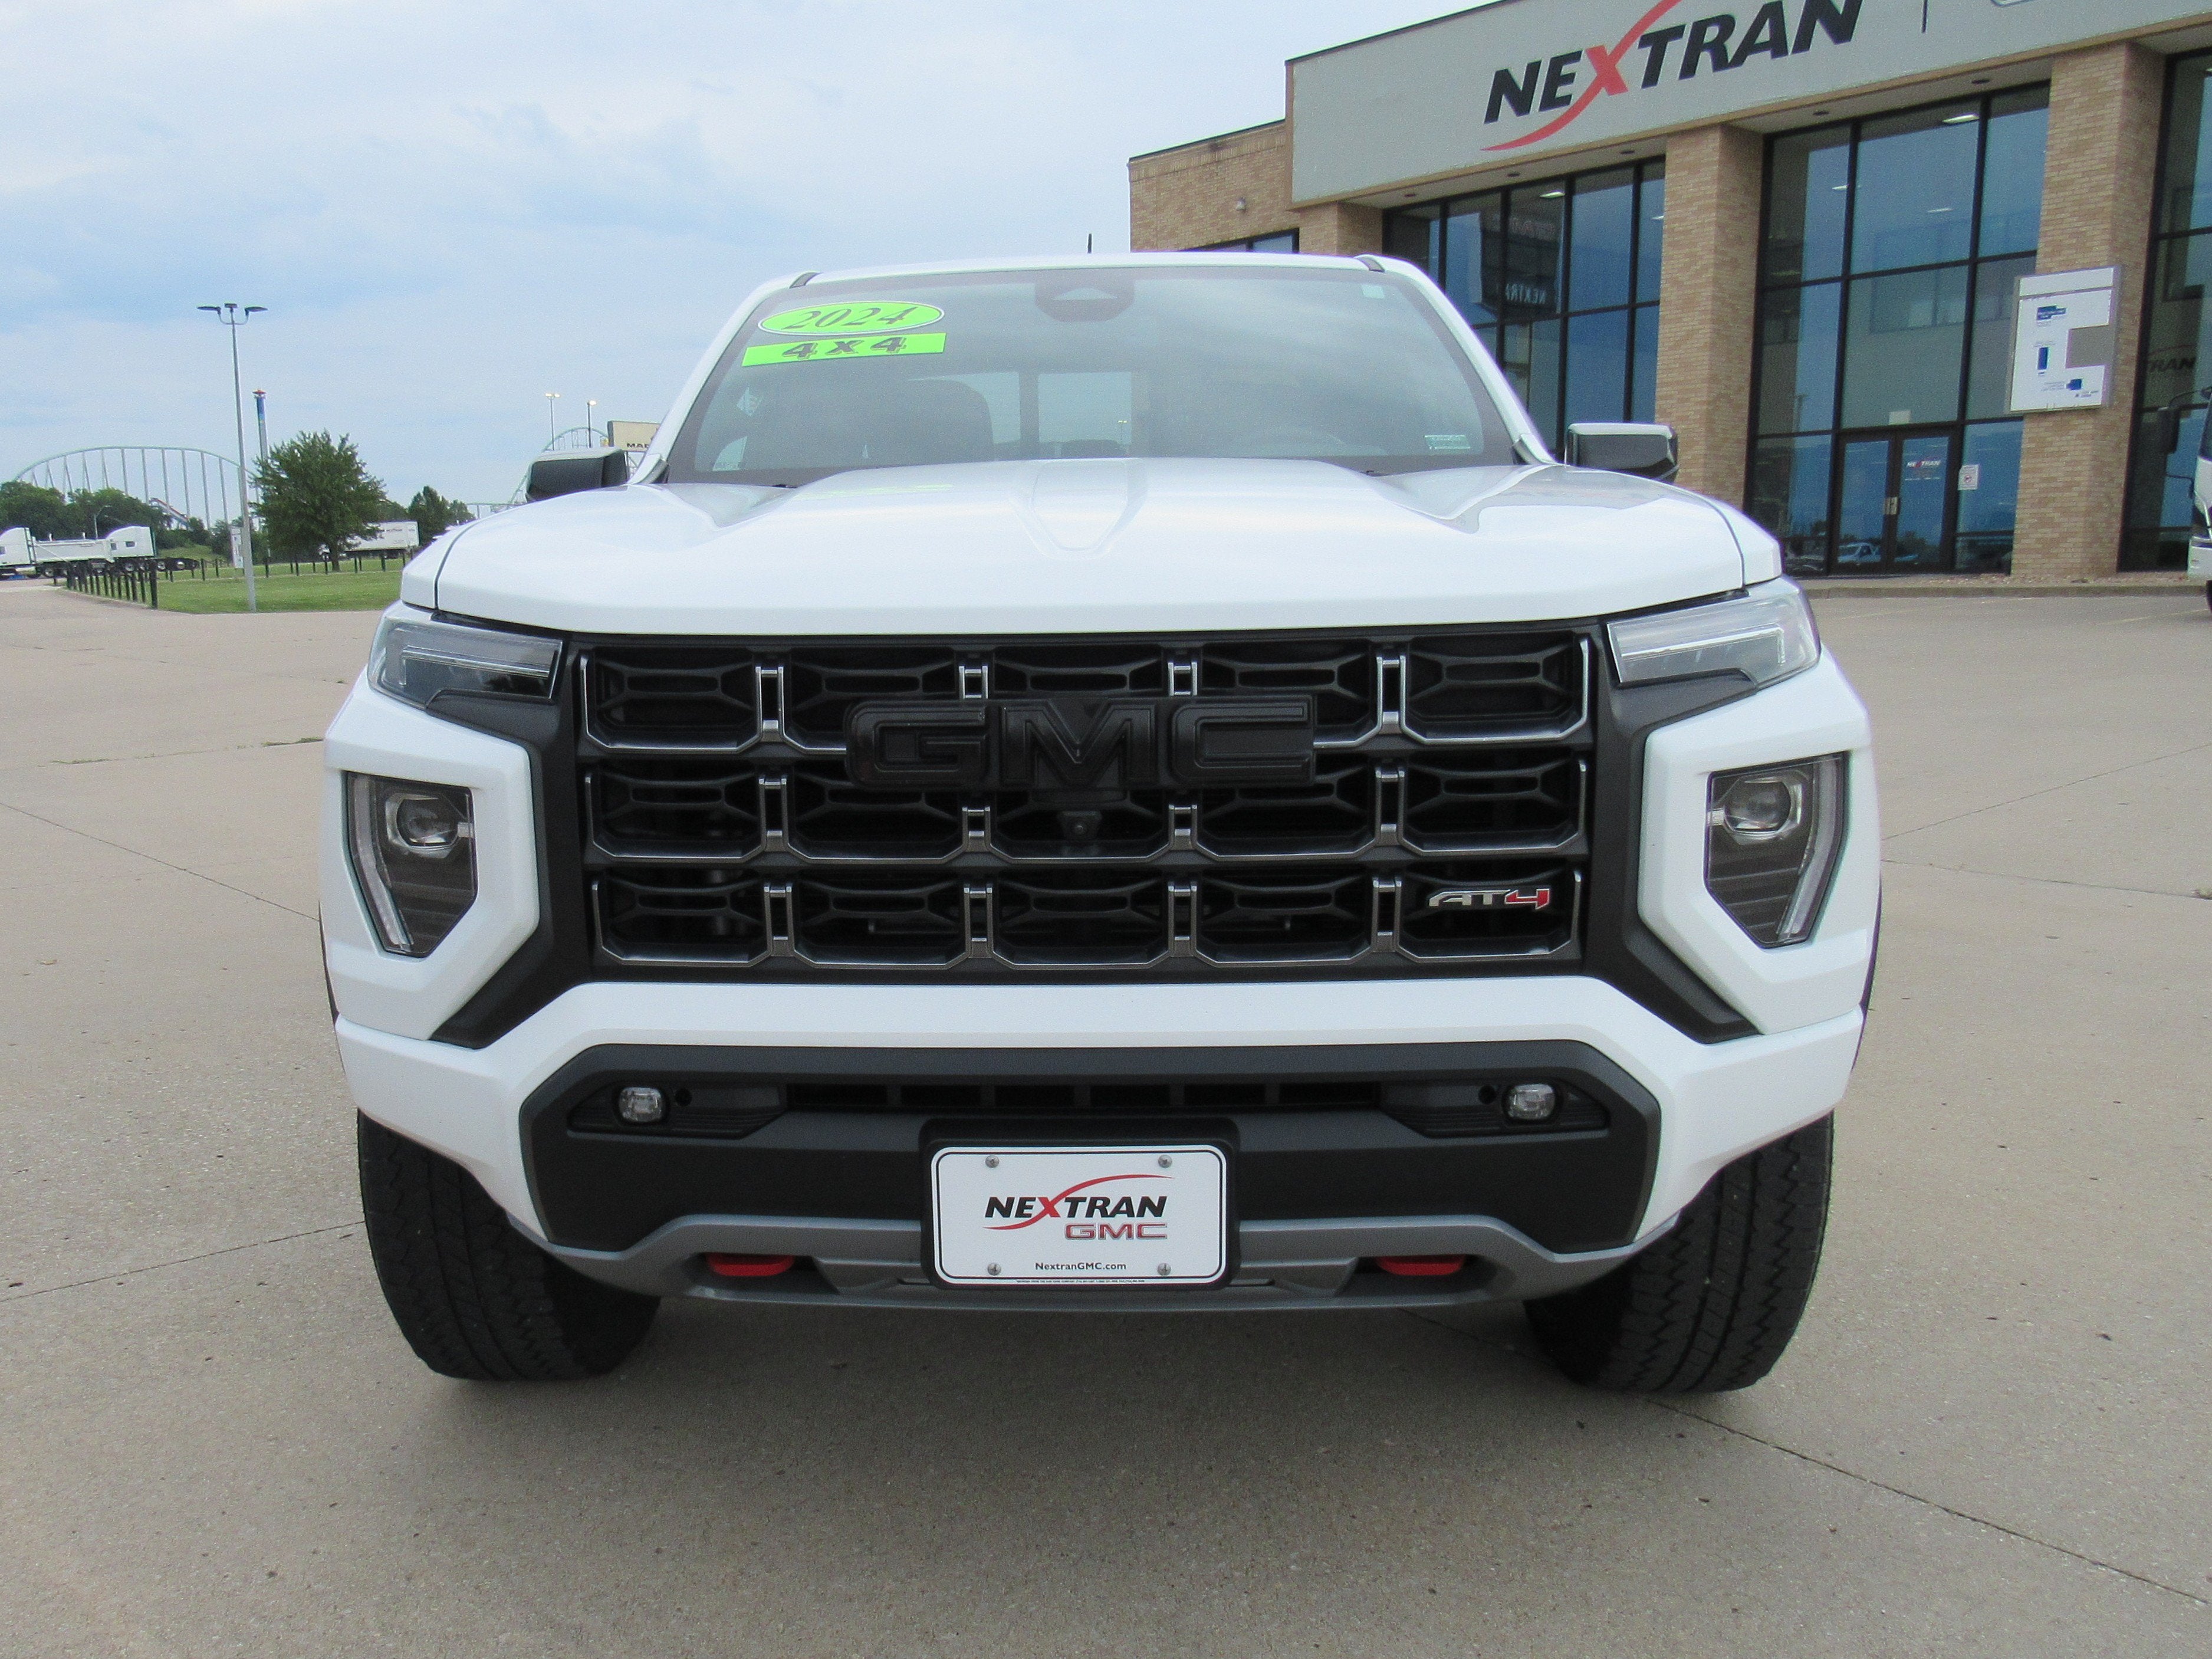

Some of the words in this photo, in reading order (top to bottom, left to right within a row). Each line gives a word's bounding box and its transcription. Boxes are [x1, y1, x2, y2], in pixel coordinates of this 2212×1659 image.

[1484, 0, 1862, 124] NEXTRAN
[781, 307, 919, 330] 2024
[844, 696, 1316, 790] GMC
[1428, 888, 1550, 910] AT4
[985, 1196, 1168, 1218] NEXTRAN
[1064, 1222, 1168, 1240] GMC
[1035, 1262, 1127, 1270] NextranGMC.com
